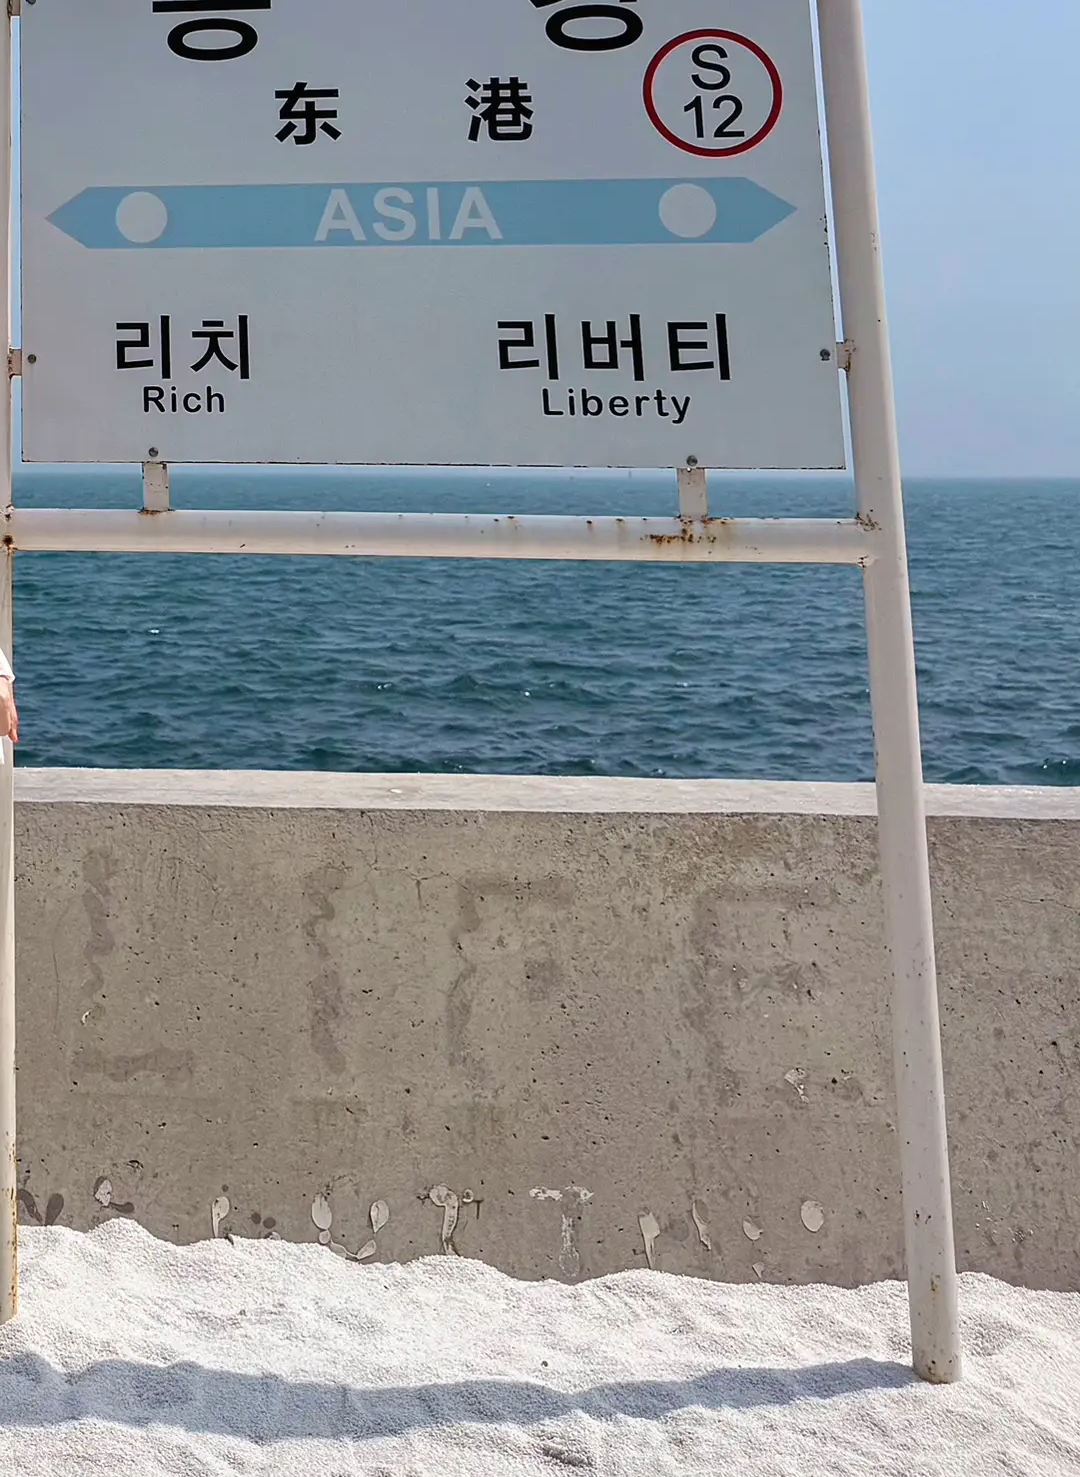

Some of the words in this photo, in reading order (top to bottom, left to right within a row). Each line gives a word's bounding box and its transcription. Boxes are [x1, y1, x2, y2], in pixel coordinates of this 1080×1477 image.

[690, 43, 732, 92] S
[682, 94, 747, 140] 12
[314, 186, 504, 241] ASIA
[114, 313, 251, 381] 리치
[496, 312, 732, 383] 리버티
[142, 384, 226, 414] Rich
[541, 386, 692, 426] Liberty
